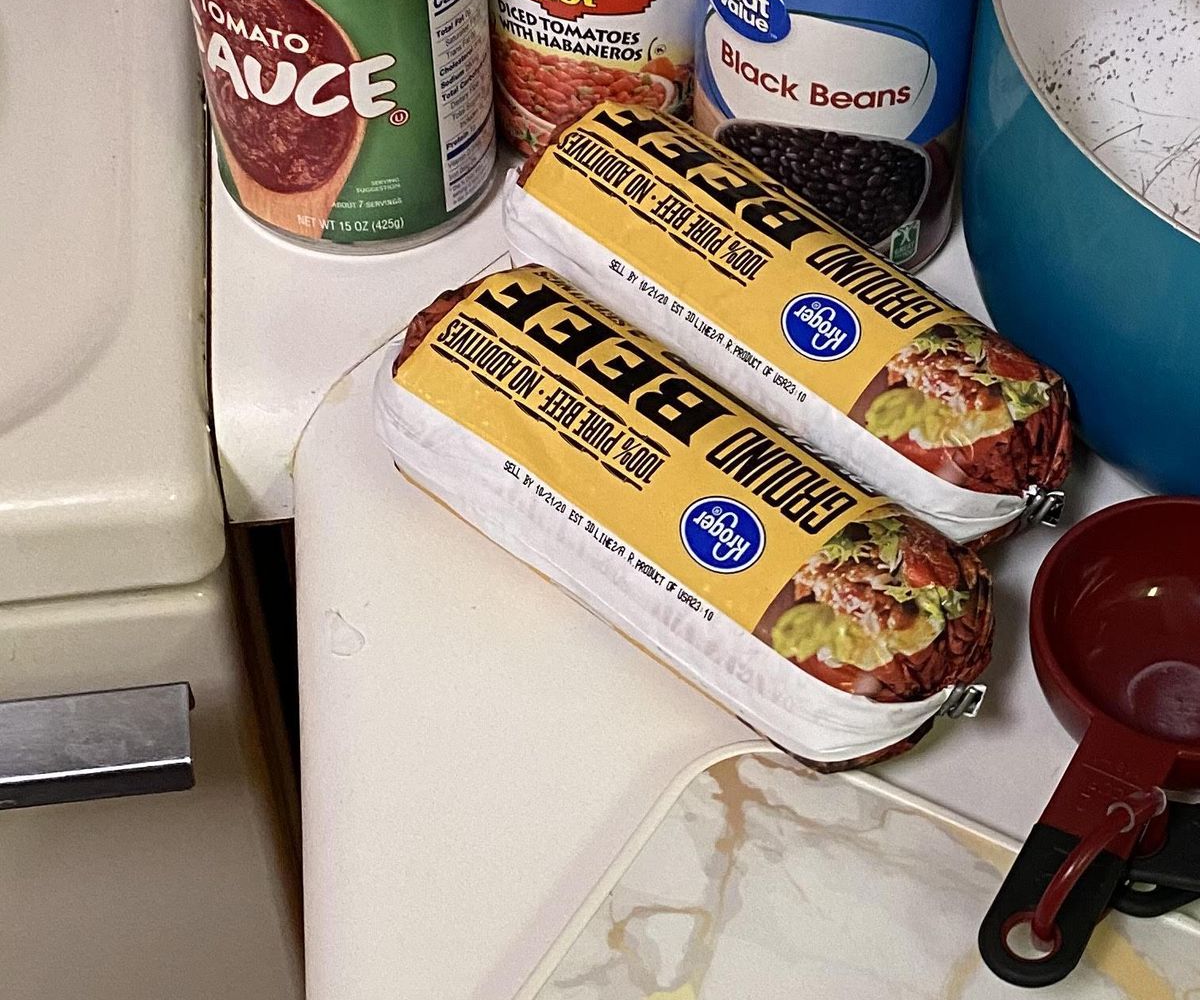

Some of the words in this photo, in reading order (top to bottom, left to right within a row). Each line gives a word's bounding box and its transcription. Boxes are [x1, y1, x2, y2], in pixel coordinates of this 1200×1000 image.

[499, 17, 534, 43] WITH
[536, 31, 643, 62] HABANEROS
[538, 16, 641, 46] TOMATOES
[203, 28, 397, 119] AUCE
[720, 38, 800, 102] Black
[809, 81, 912, 110] Beans
[558, 131, 640, 190] ADDITIVES
[593, 109, 832, 251] BEEF
[358, 200, 365, 209] 7
[365, 197, 403, 209] SERVINGS
[623, 175, 658, 205] NO
[650, 193, 700, 231] BEEF
[297, 214, 317, 228] NET
[319, 219, 337, 231] WT
[339, 221, 352, 232] 15
[354, 221, 369, 232] OZ
[371, 216, 405, 233] (425g)
[686, 208, 734, 258] PURE
[720, 238, 769, 282] 100%
[805, 243, 944, 330] GROUND
[608, 258, 625, 277] SELL
[627, 271, 640, 285] BY
[638, 279, 670, 306] 10/21/20
[669, 300, 685, 318] EST
[761, 364, 775, 377] OF
[793, 301, 848, 351] Kroger
[437, 318, 527, 387] ADDITIVES
[474, 281, 738, 447] BEEF
[509, 369, 546, 400] NO
[538, 386, 590, 424] BEEF
[571, 407, 627, 457] PURE
[613, 438, 666, 485] 100%
[705, 426, 858, 536] GROUND
[503, 460, 521, 480] SELL
[522, 473, 535, 488] BY
[535, 483, 568, 514] 10/21/20
[568, 509, 584, 527] EST
[666, 579, 679, 593] OF
[692, 510, 751, 563] Kroger
